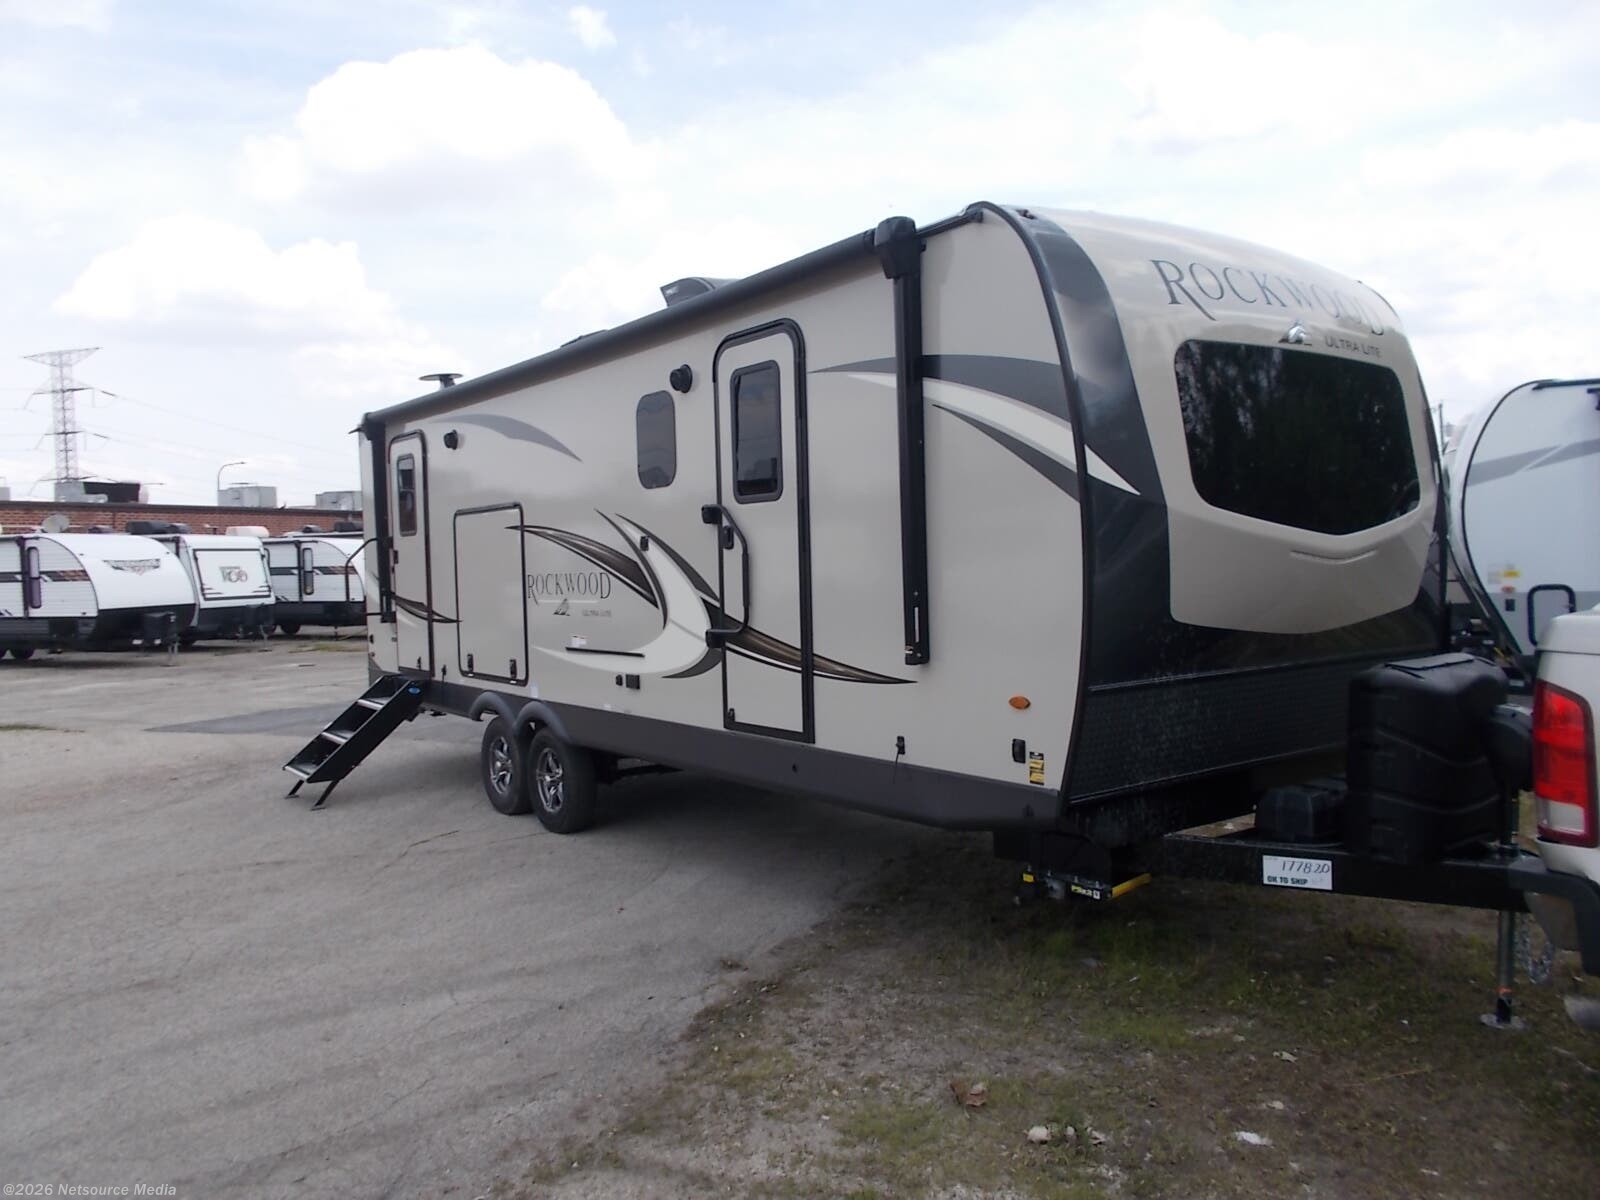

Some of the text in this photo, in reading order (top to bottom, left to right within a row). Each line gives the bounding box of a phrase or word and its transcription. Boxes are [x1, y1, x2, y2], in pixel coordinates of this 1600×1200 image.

[1150, 259, 1385, 335] ROCKWOOD
[1324, 335, 1360, 352] ULTRA
[527, 572, 611, 605] ROCKWOOD
[1267, 875, 1308, 885] OK TO SHIP
